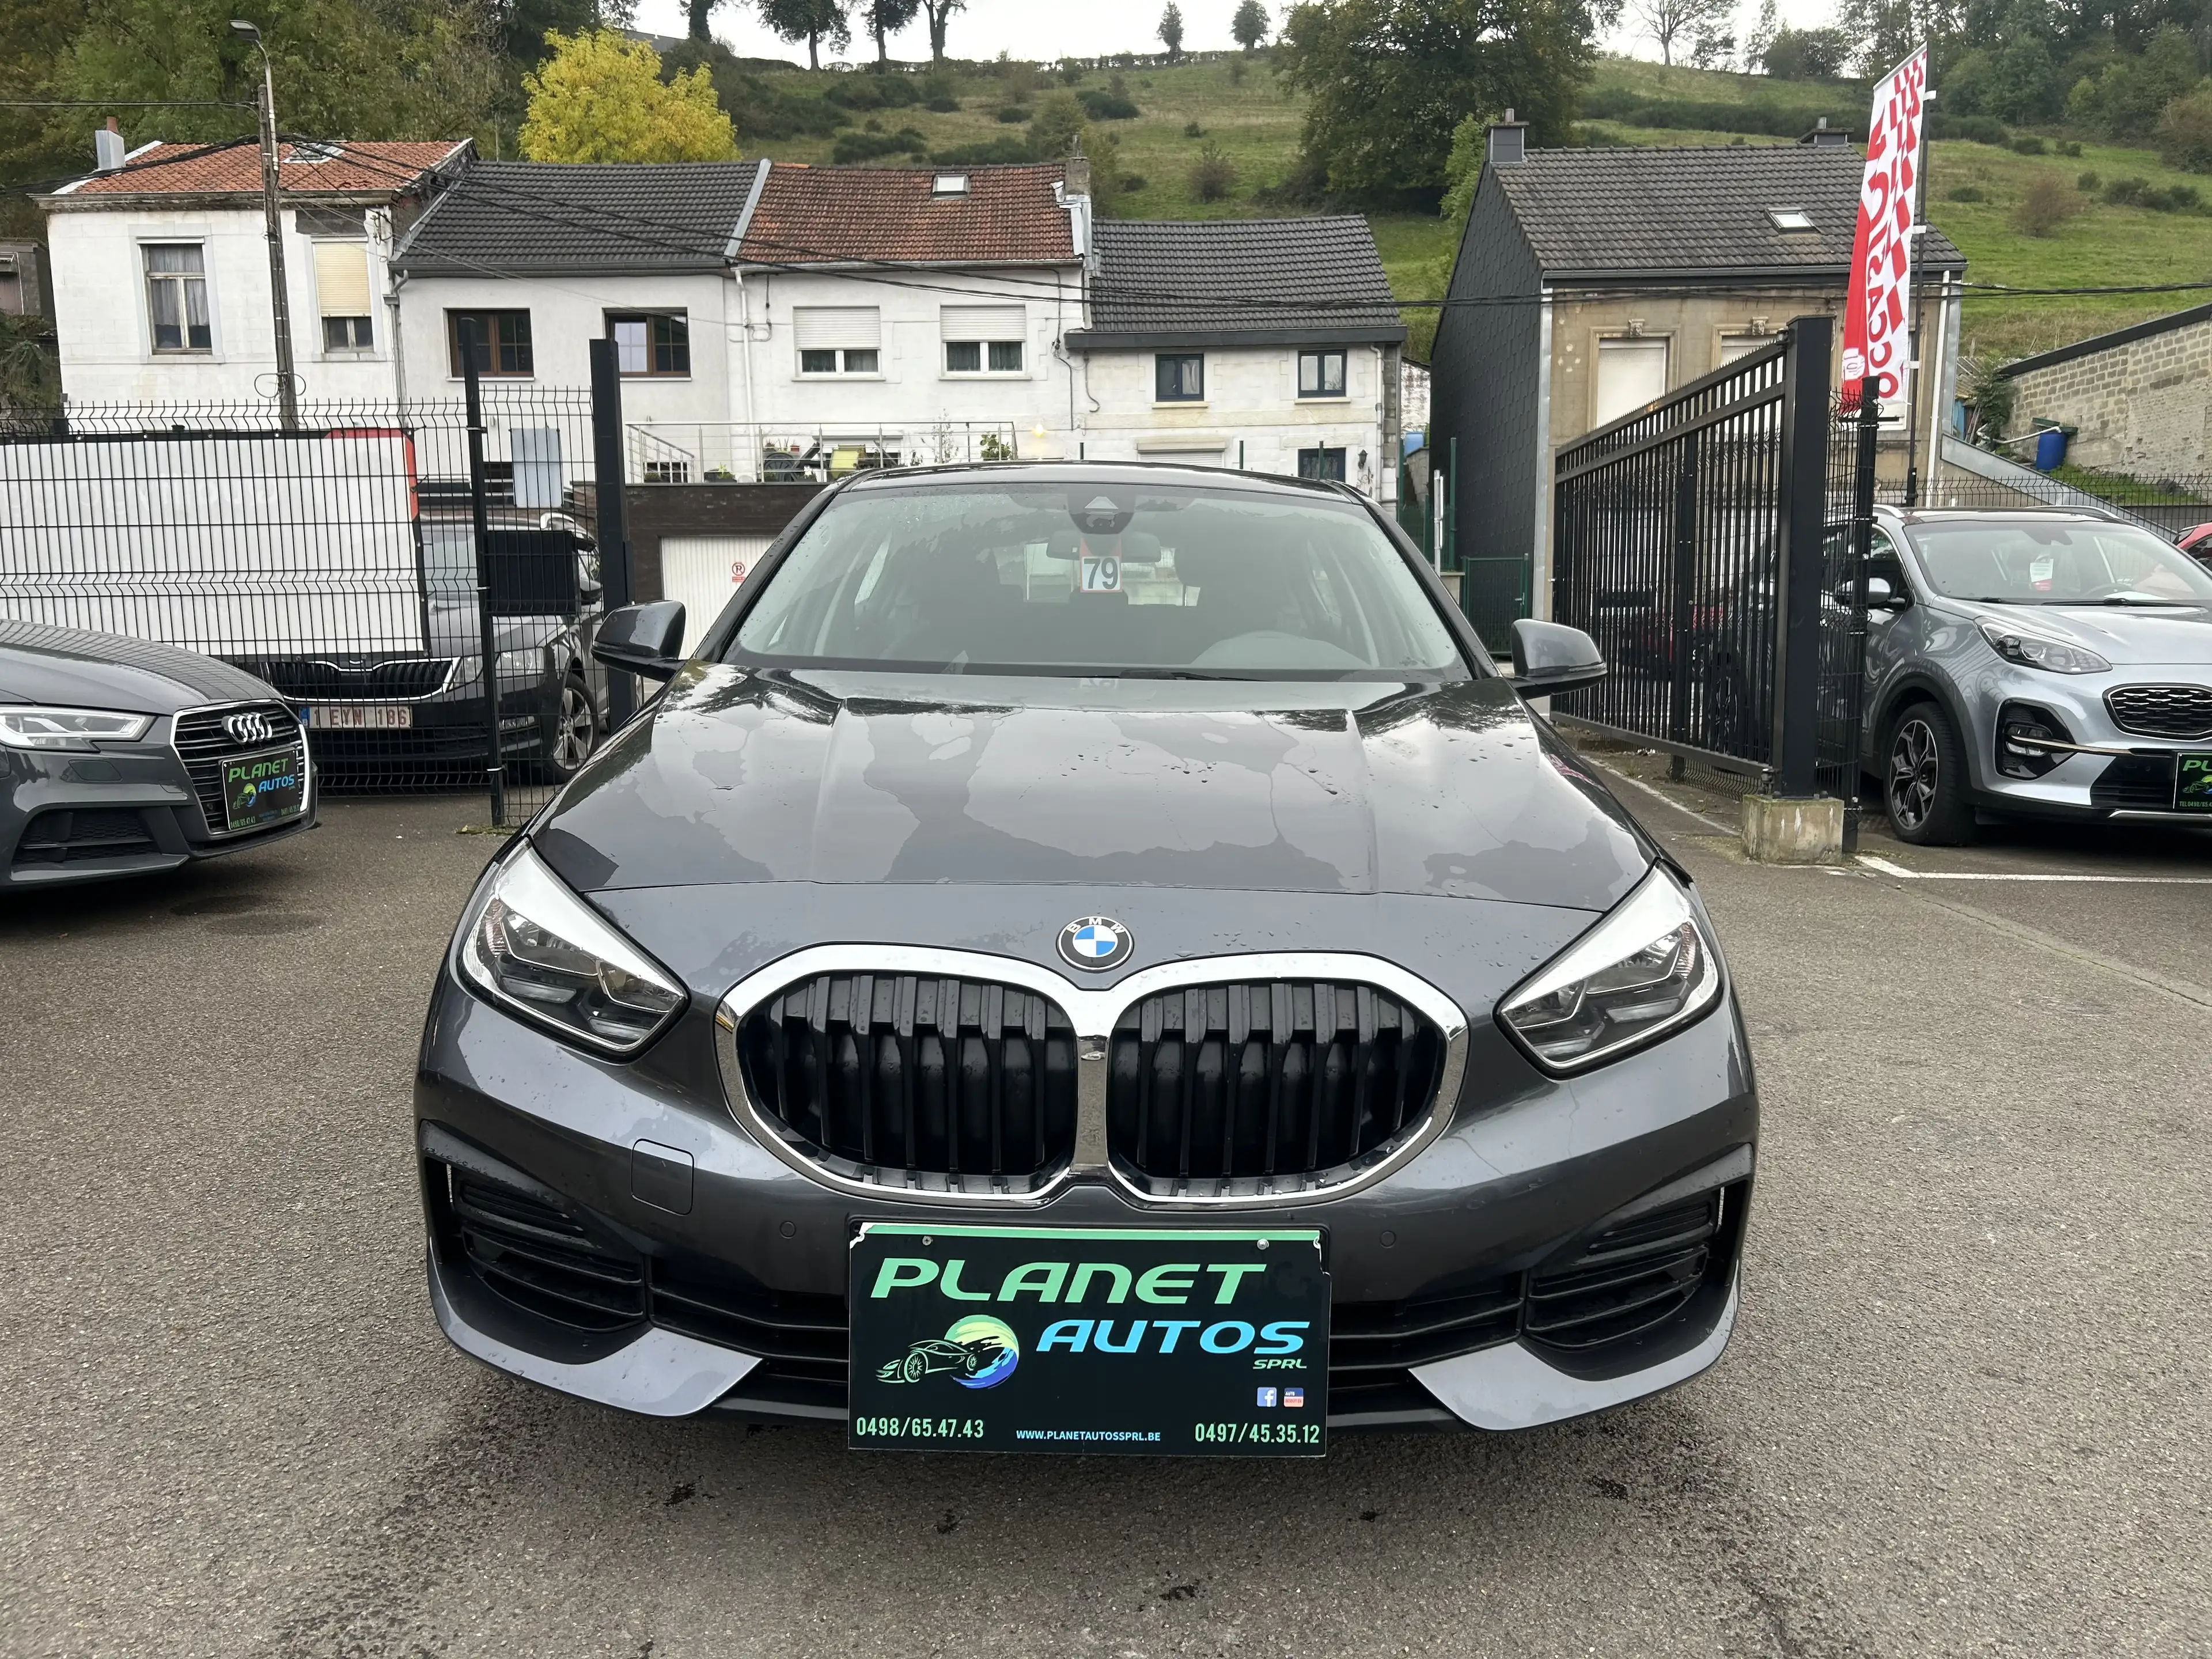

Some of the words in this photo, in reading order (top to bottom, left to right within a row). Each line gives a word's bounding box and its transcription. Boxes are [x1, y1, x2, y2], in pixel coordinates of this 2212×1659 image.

[1084, 557, 1118, 590] 79
[377, 709, 407, 725] 186
[228, 758, 289, 783] PLANET
[259, 774, 295, 793] AUTOS
[1066, 917, 1125, 934] BMW
[870, 1257, 1267, 1305] PLANET
[1036, 1319, 1310, 1354] AUTOS
[1252, 1359, 1307, 1370] SPRL
[856, 1417, 984, 1439] 0498/65.47.43
[1016, 1428, 1161, 1442] WWW.PLANETAUTOSSPRL.BE
[1194, 1423, 1320, 1445] 0497/45.35.12
